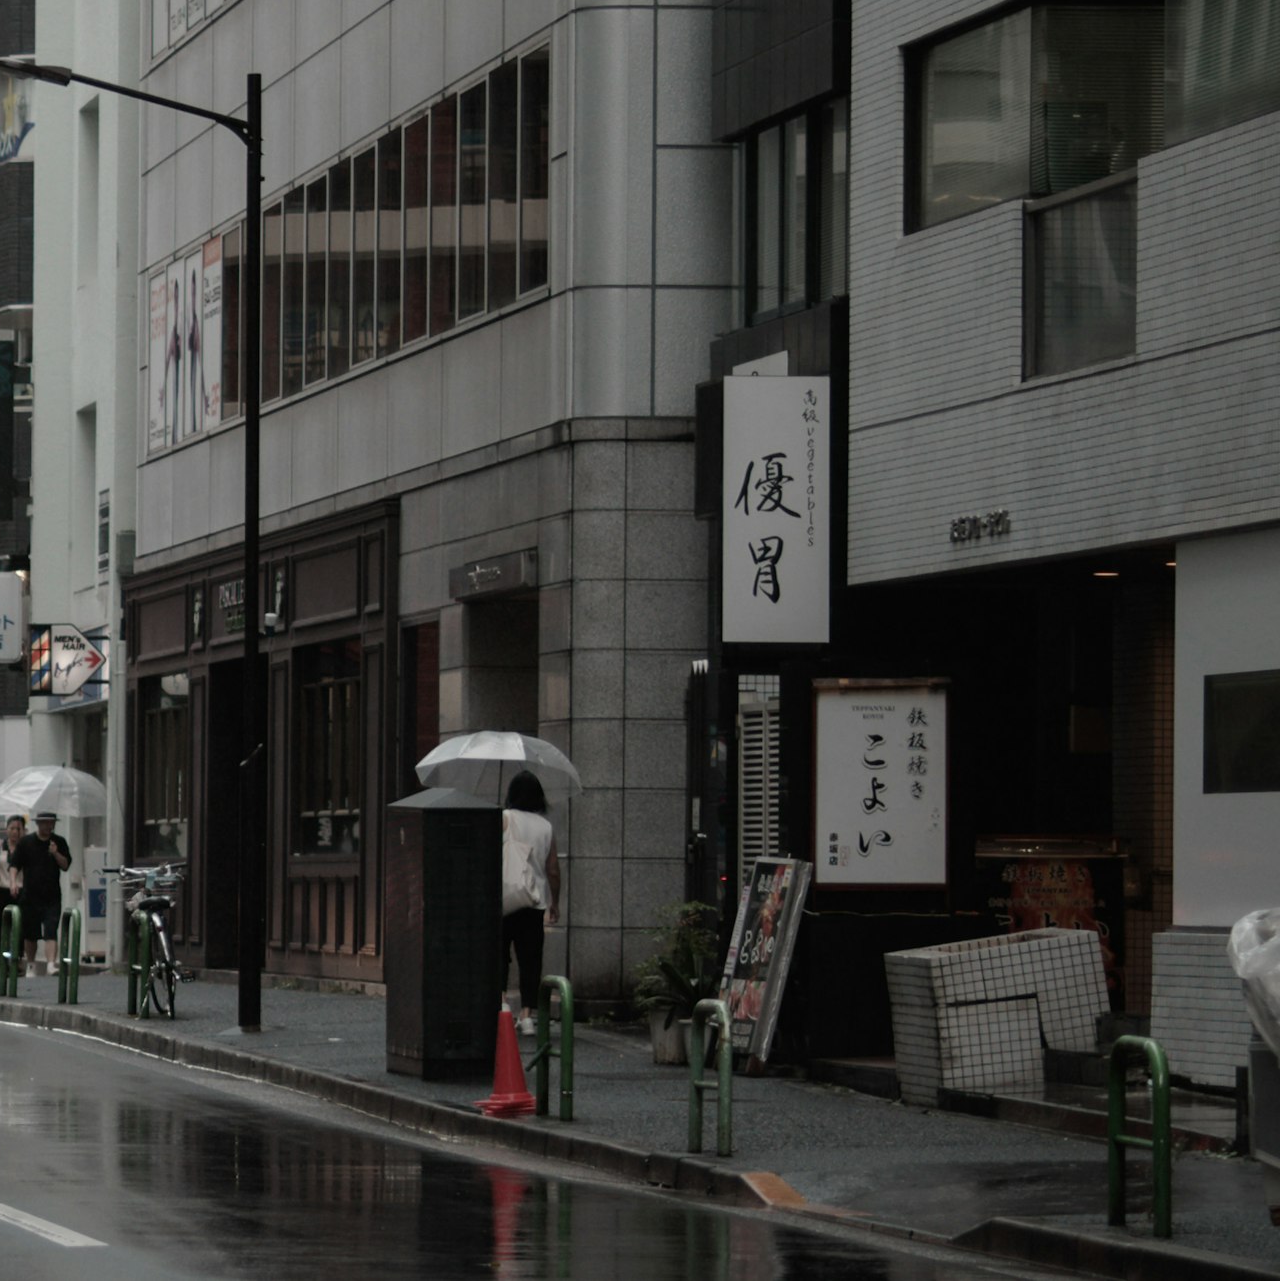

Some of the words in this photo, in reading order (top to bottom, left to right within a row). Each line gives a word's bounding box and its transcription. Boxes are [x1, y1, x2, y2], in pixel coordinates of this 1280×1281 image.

[857, 733, 895, 859] こよい
[828, 832, 839, 866] 赤坂店
